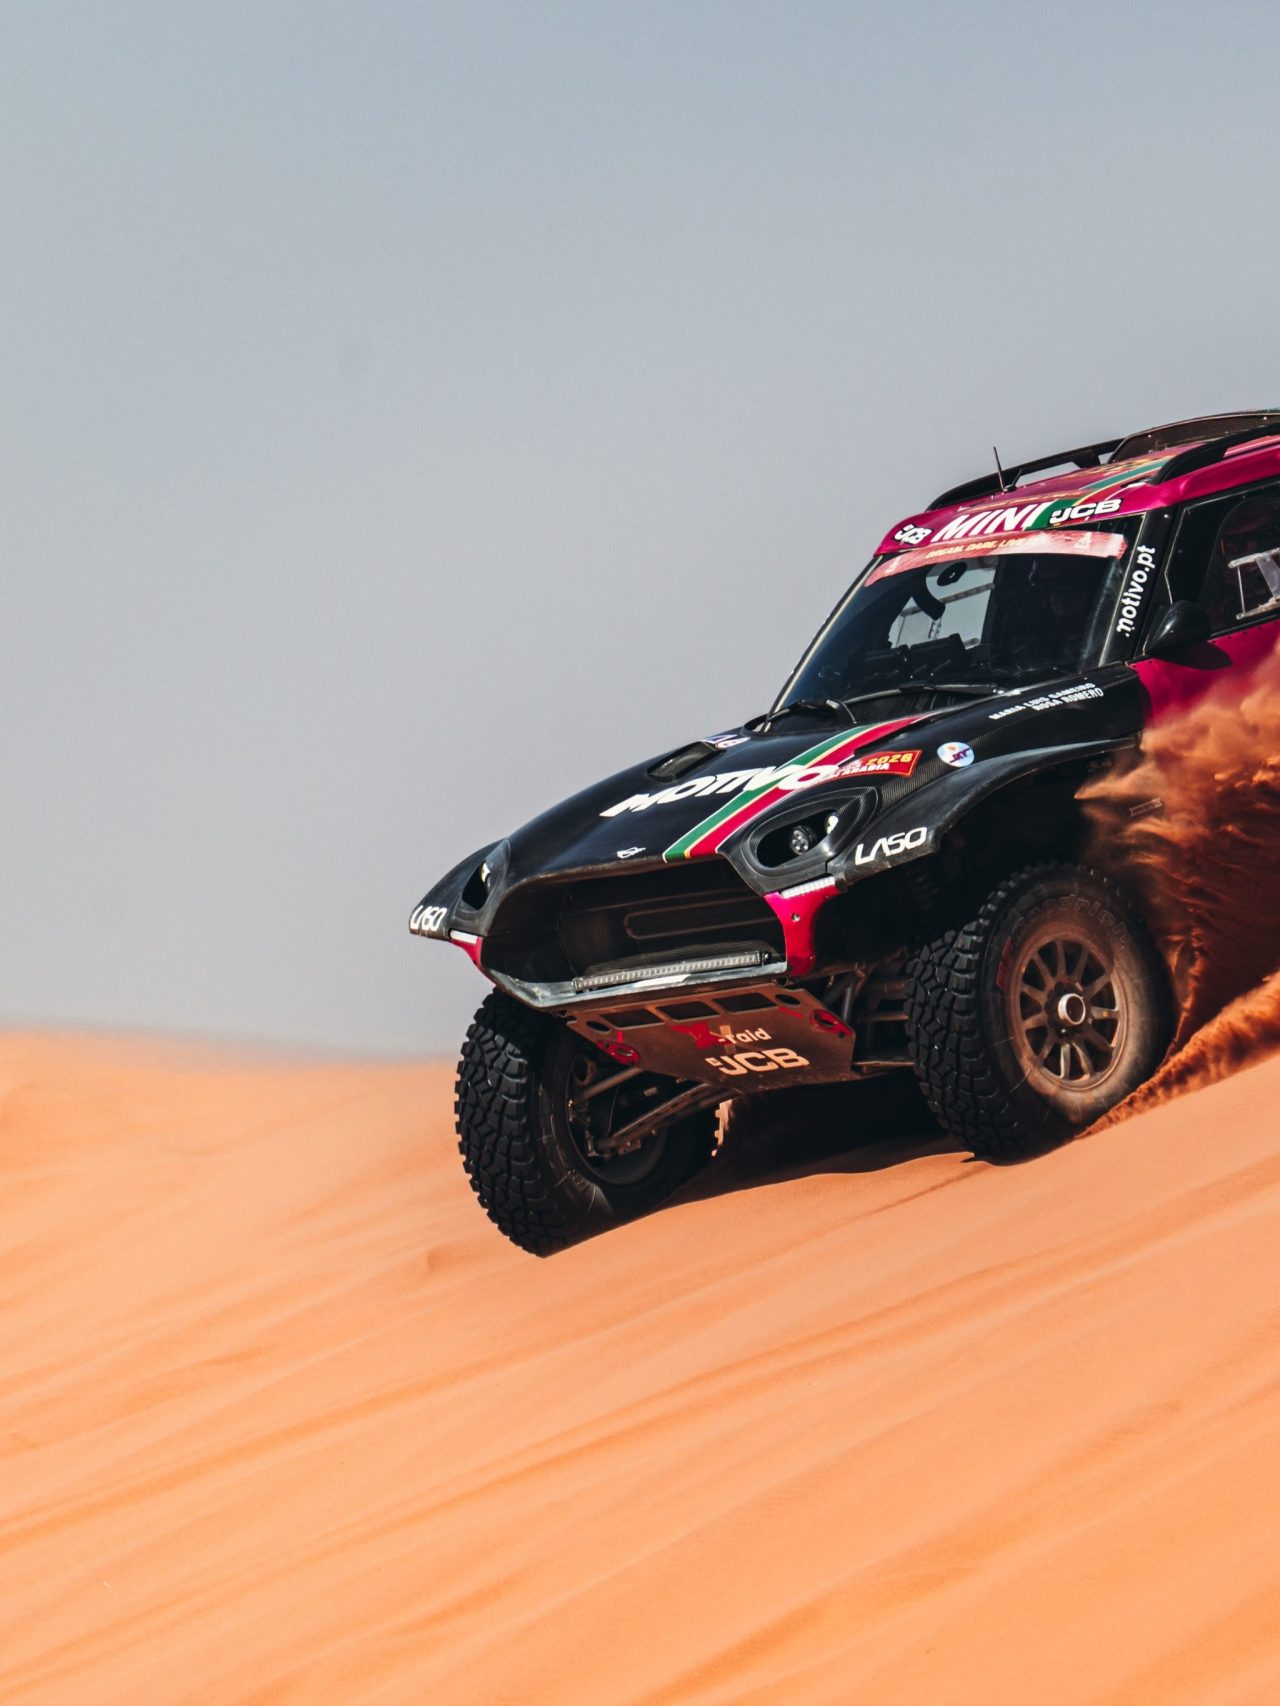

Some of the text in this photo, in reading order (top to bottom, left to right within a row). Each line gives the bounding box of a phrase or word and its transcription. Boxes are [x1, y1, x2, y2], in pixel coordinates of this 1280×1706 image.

[930, 499, 1057, 543] MINI
[1049, 499, 1122, 525] JCB
[1061, 687, 1104, 703] ROMERO
[599, 764, 838, 817] MOTIVO
[854, 826, 928, 865] LASO
[705, 1047, 810, 1076] JCB
